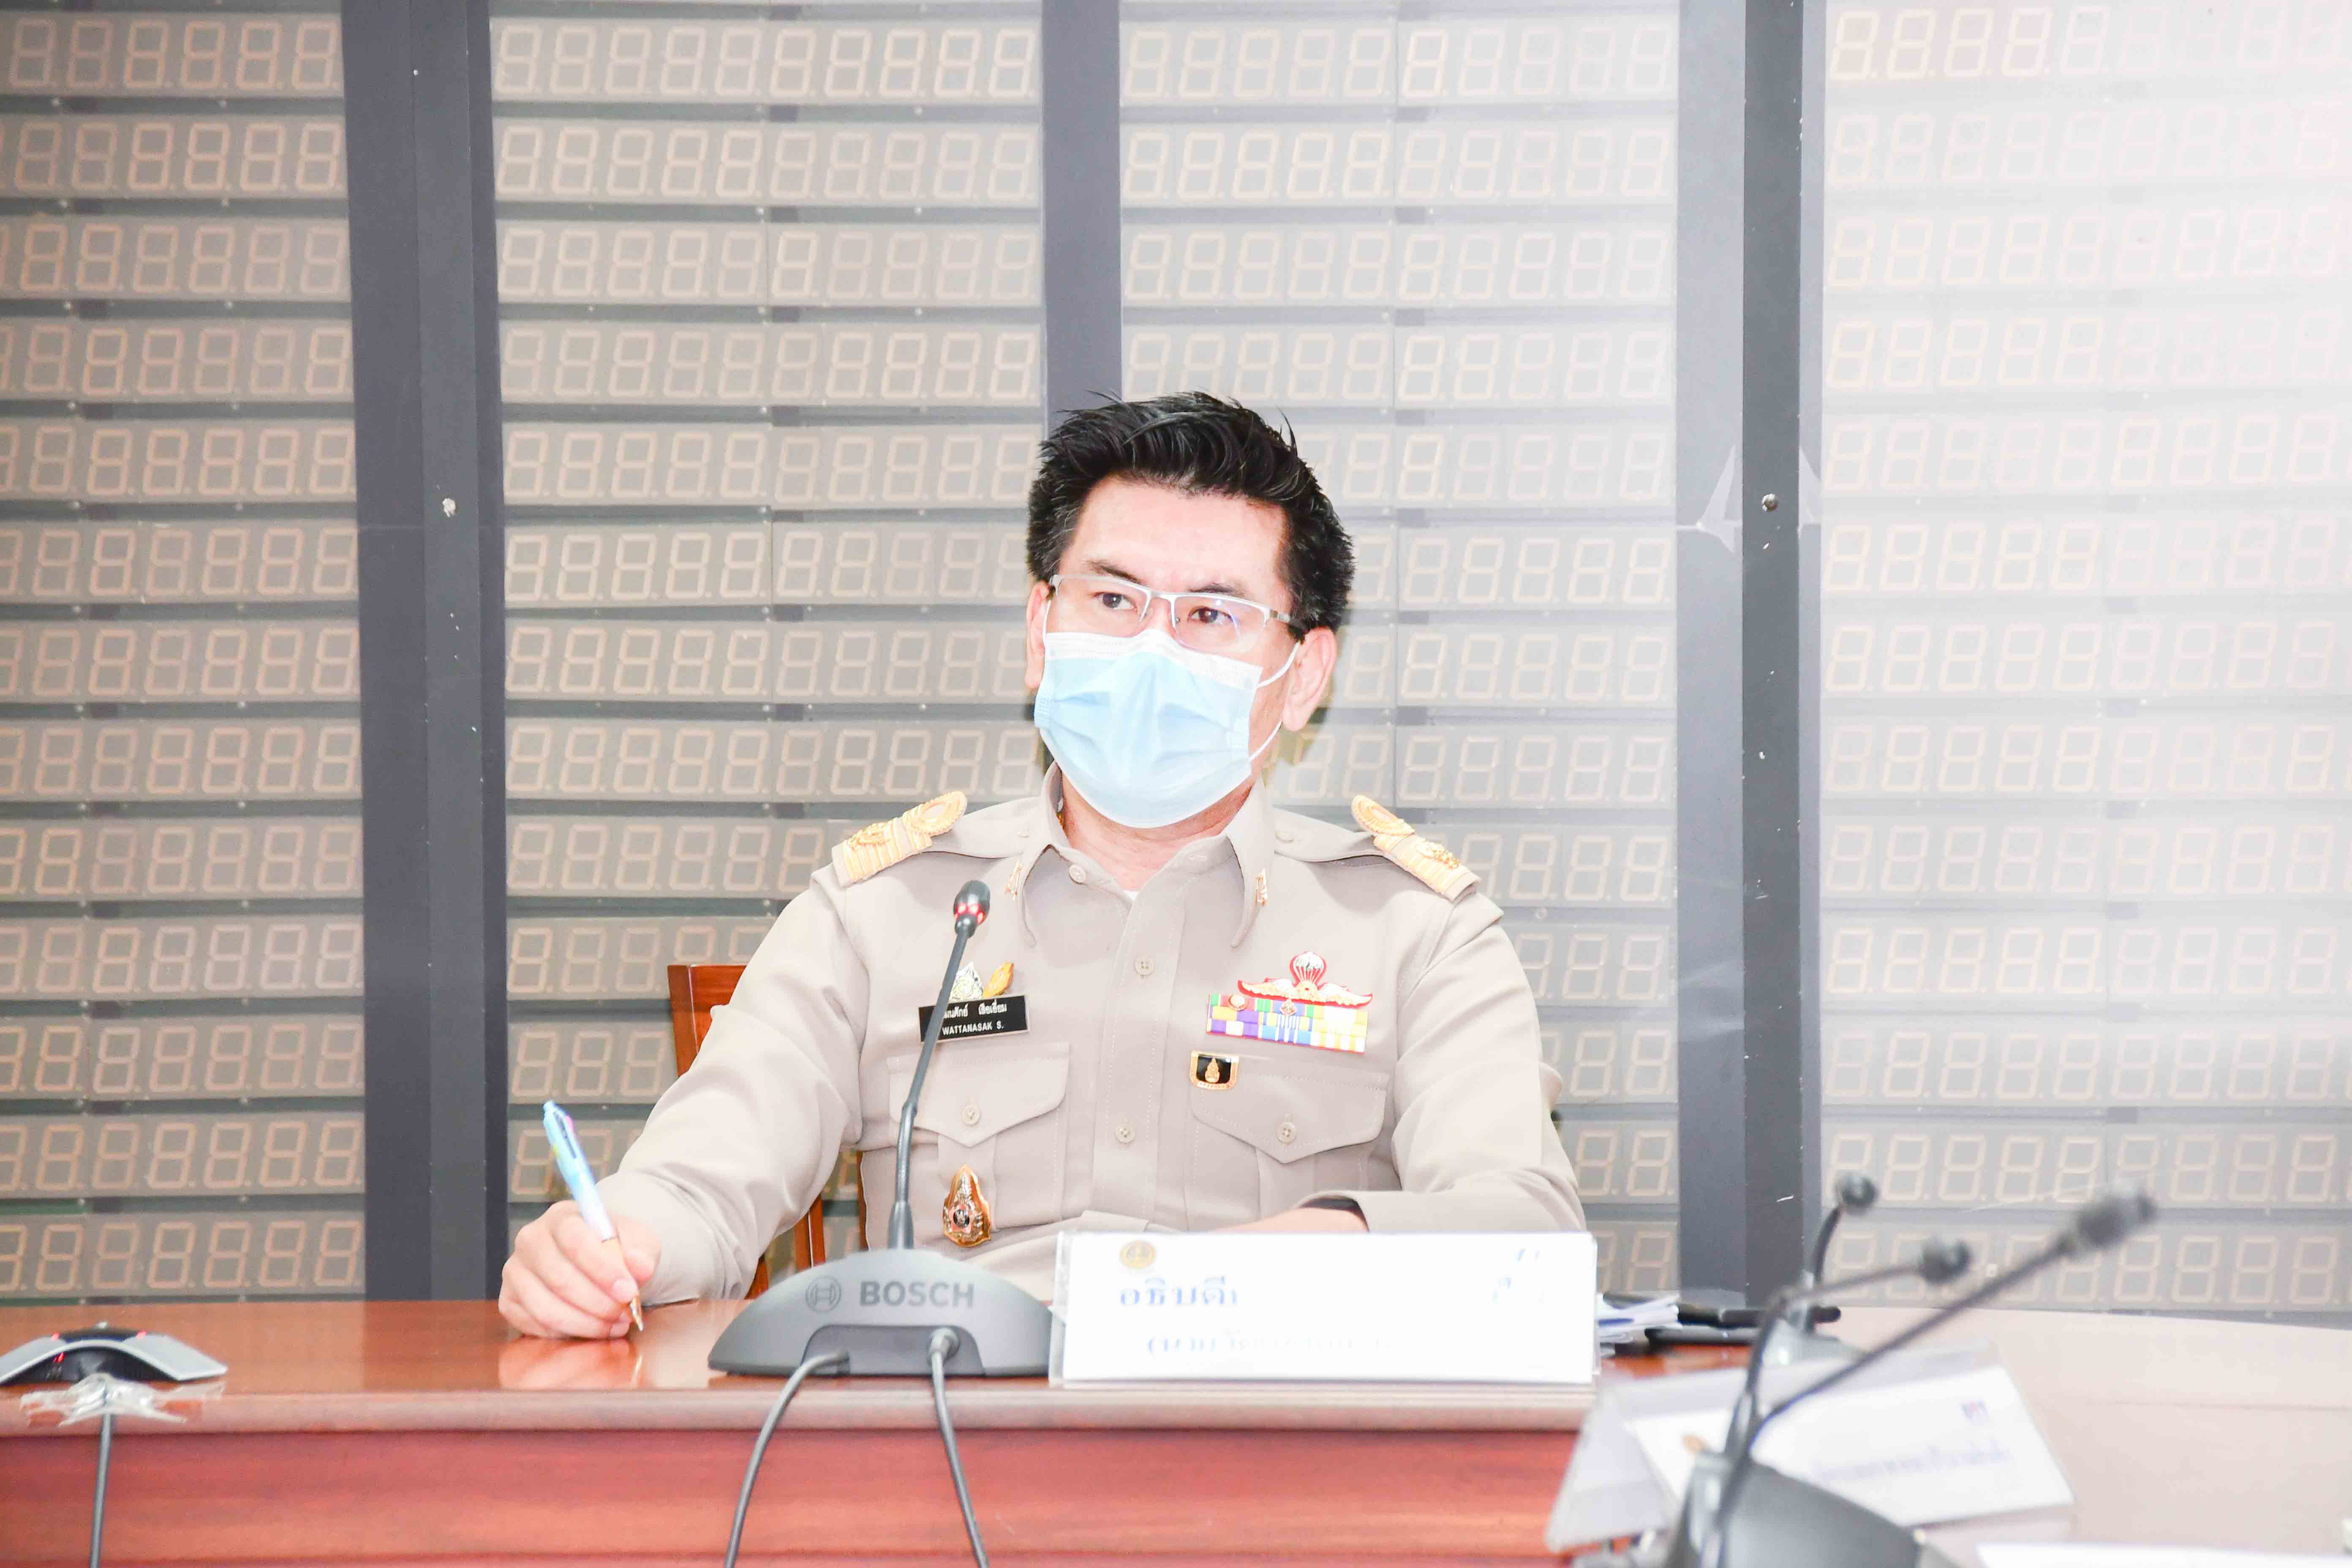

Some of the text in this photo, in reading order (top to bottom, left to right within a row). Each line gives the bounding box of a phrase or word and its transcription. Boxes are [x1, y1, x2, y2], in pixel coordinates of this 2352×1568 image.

[942, 1020, 1004, 1036] WATTANASAK S.
[859, 1280, 975, 1308] BOSCH
